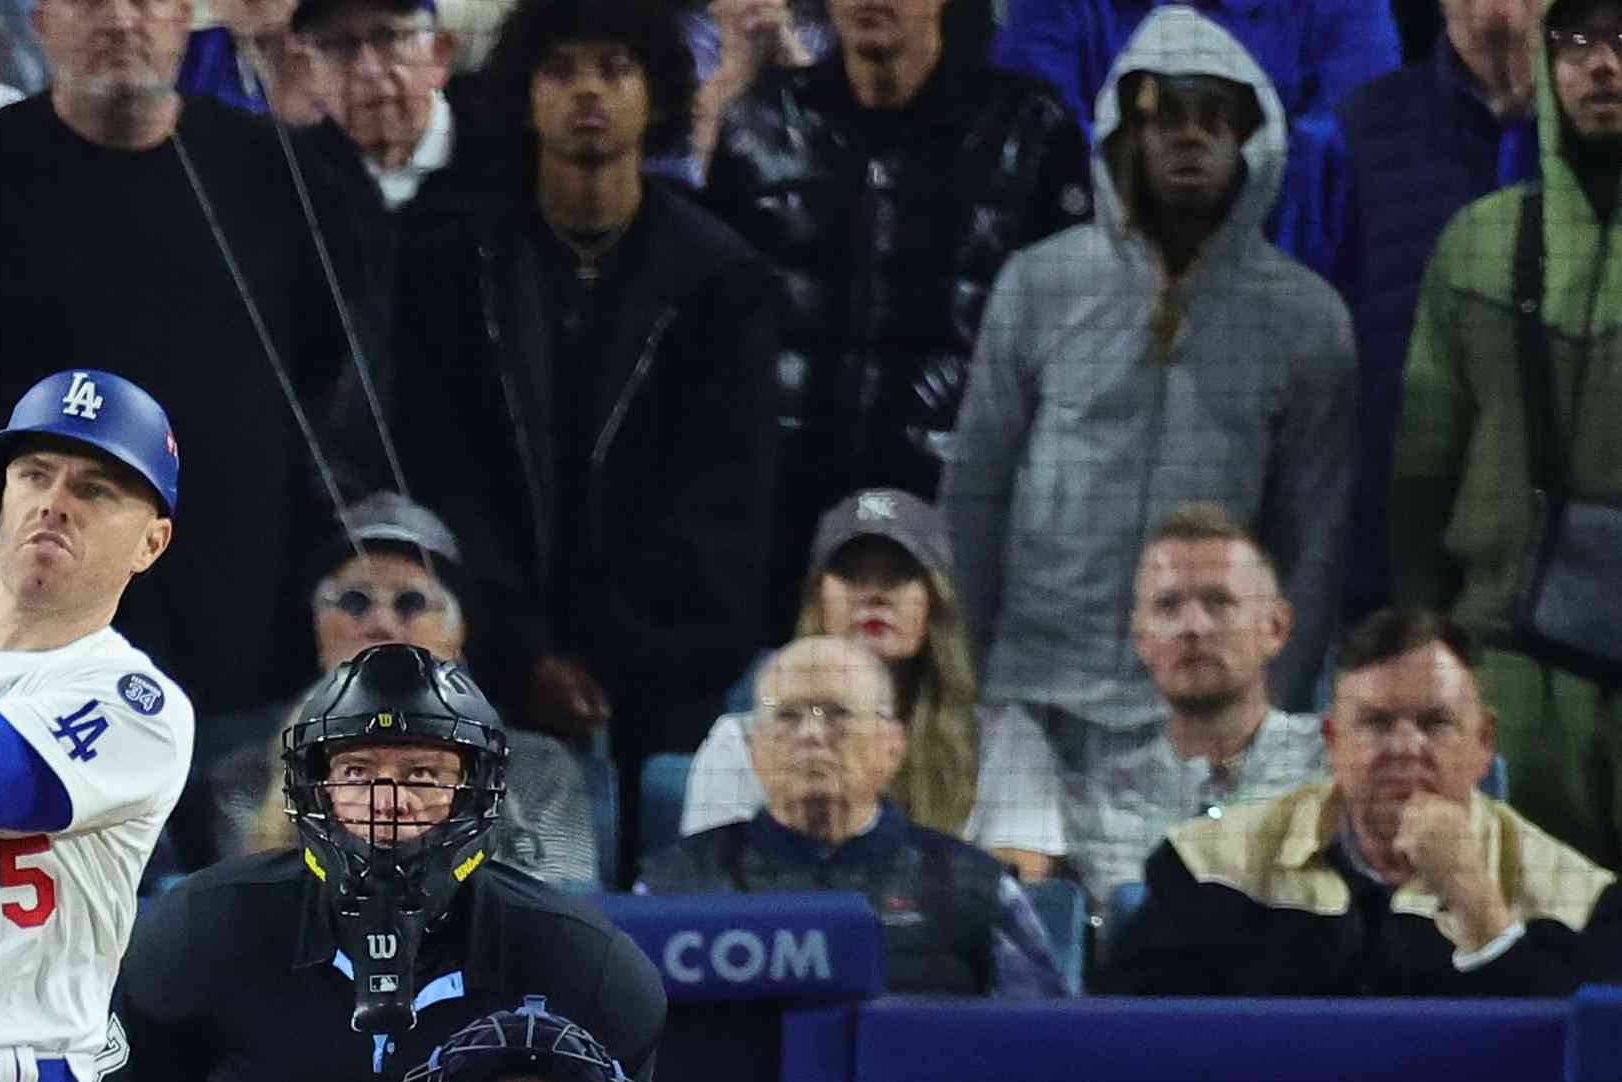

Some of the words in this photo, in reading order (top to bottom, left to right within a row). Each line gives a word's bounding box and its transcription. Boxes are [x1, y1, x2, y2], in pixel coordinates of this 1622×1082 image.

[62, 371, 104, 420] LA
[124, 682, 157, 711] 34
[47, 698, 110, 763] LA
[662, 930, 832, 983] COM
